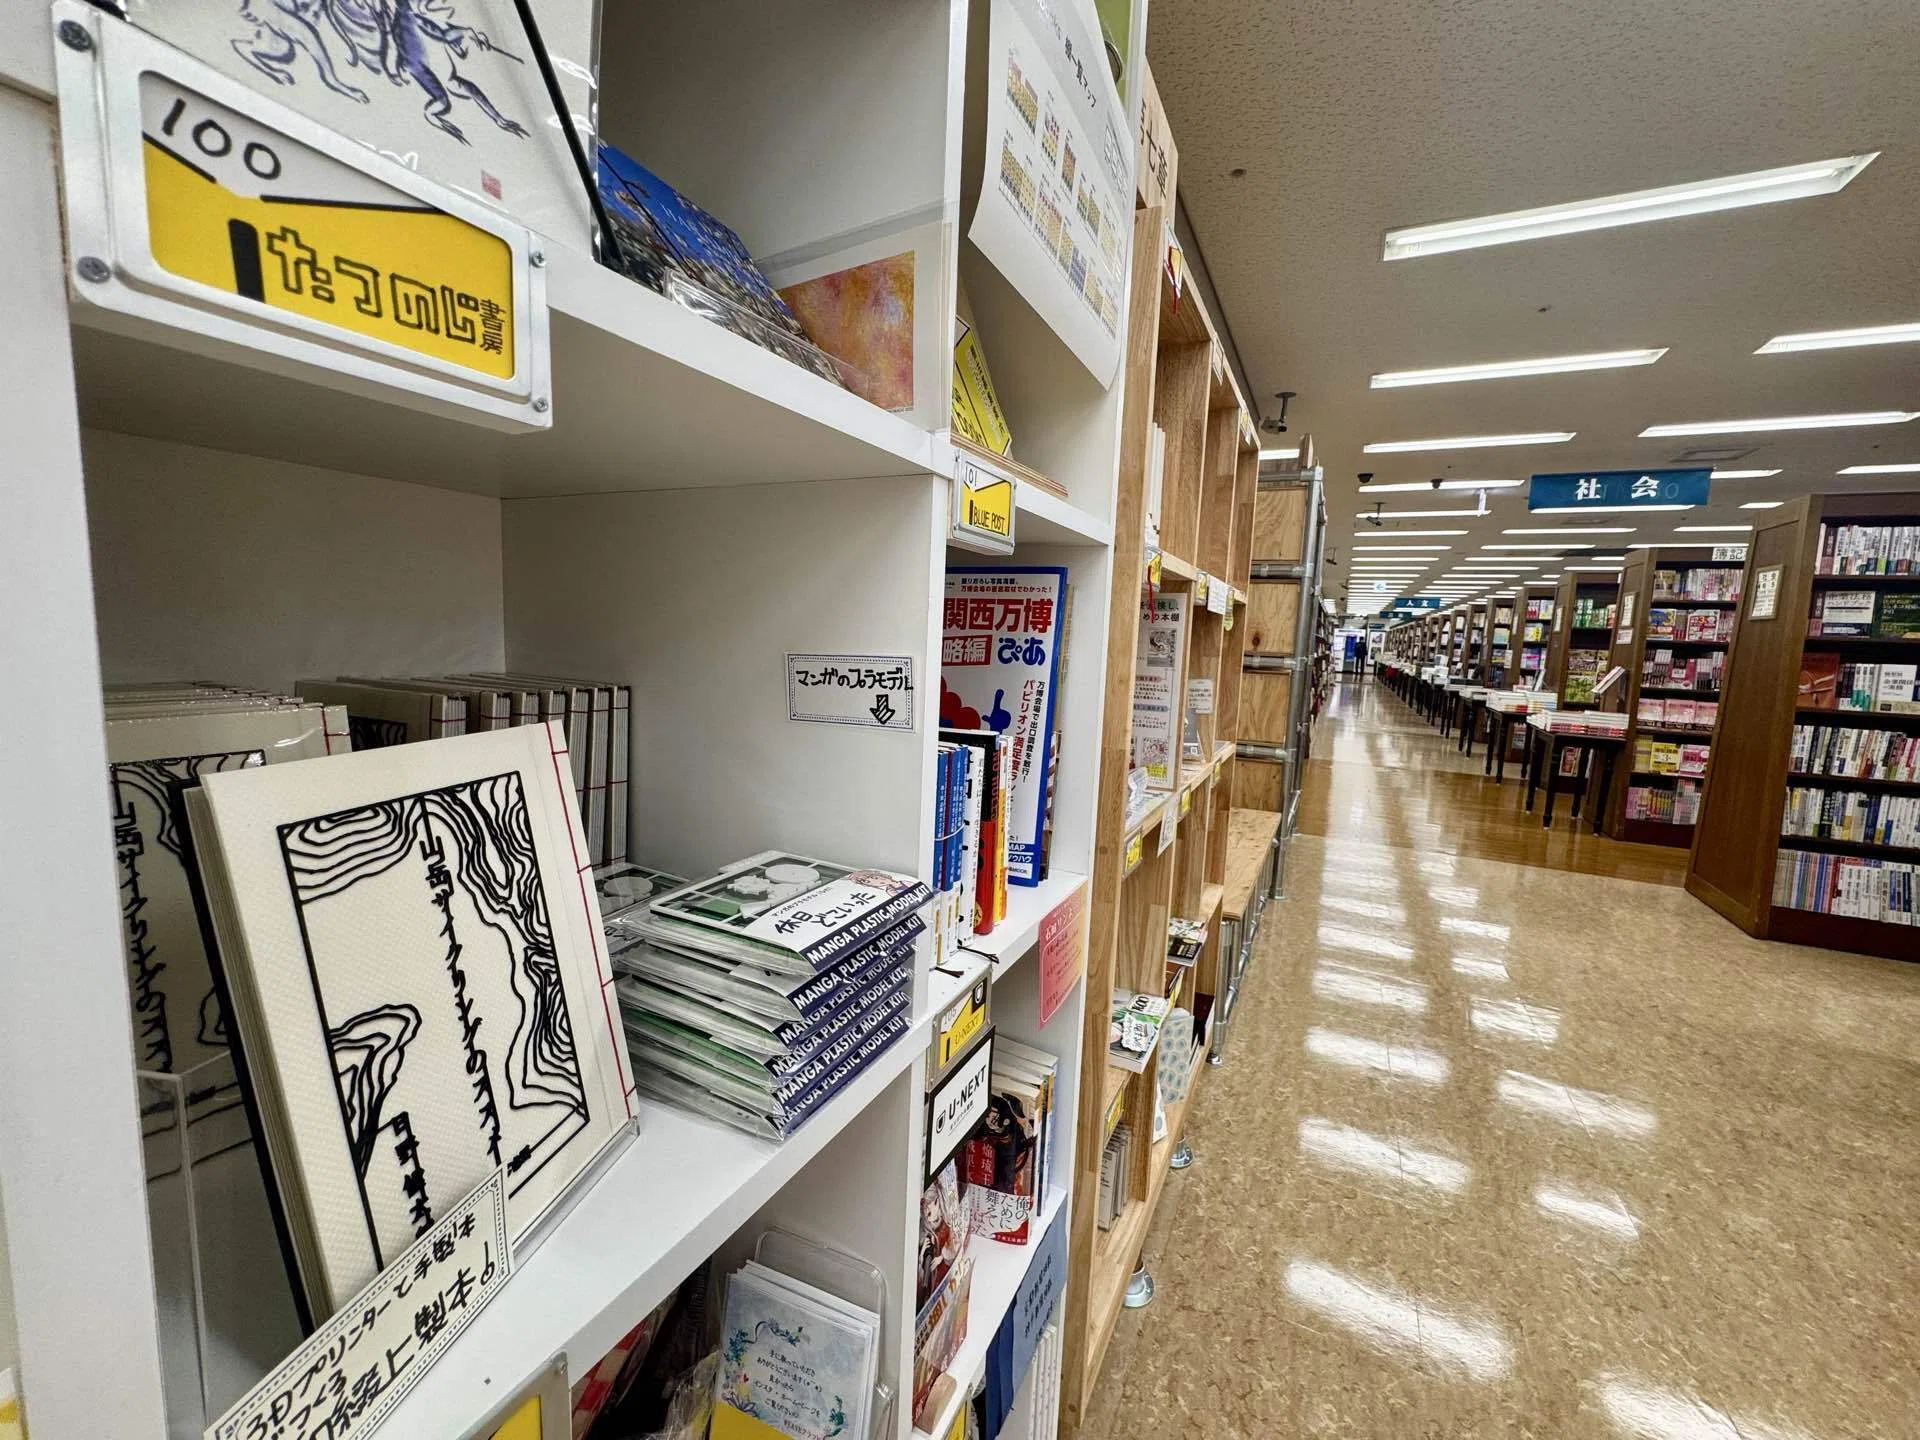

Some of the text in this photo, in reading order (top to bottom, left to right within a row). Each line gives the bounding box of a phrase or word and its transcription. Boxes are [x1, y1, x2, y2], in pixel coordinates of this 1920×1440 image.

[163, 98, 282, 181] 100
[965, 465, 978, 487] 101
[1574, 475, 1660, 501] 社会
[974, 506, 1005, 533] BLUE POST
[943, 598, 1053, 633] 関西万博
[998, 637, 1046, 666] ぴあ
[796, 667, 914, 691] マンガのプラモデル
[807, 884, 931, 963] MANGA PLASTIC MODEL KIT
[793, 914, 922, 1012] MANGA PLASTIC MODEL KIT
[772, 967, 907, 1078] MANGA PLASTIC MODEL KIT
[859, 1026, 890, 1064] MODEL
[888, 1015, 905, 1037] KIT
[776, 991, 907, 1105] MANGA PLASTIC MODEL KIT
[949, 1065, 987, 1121] U-NEXT
